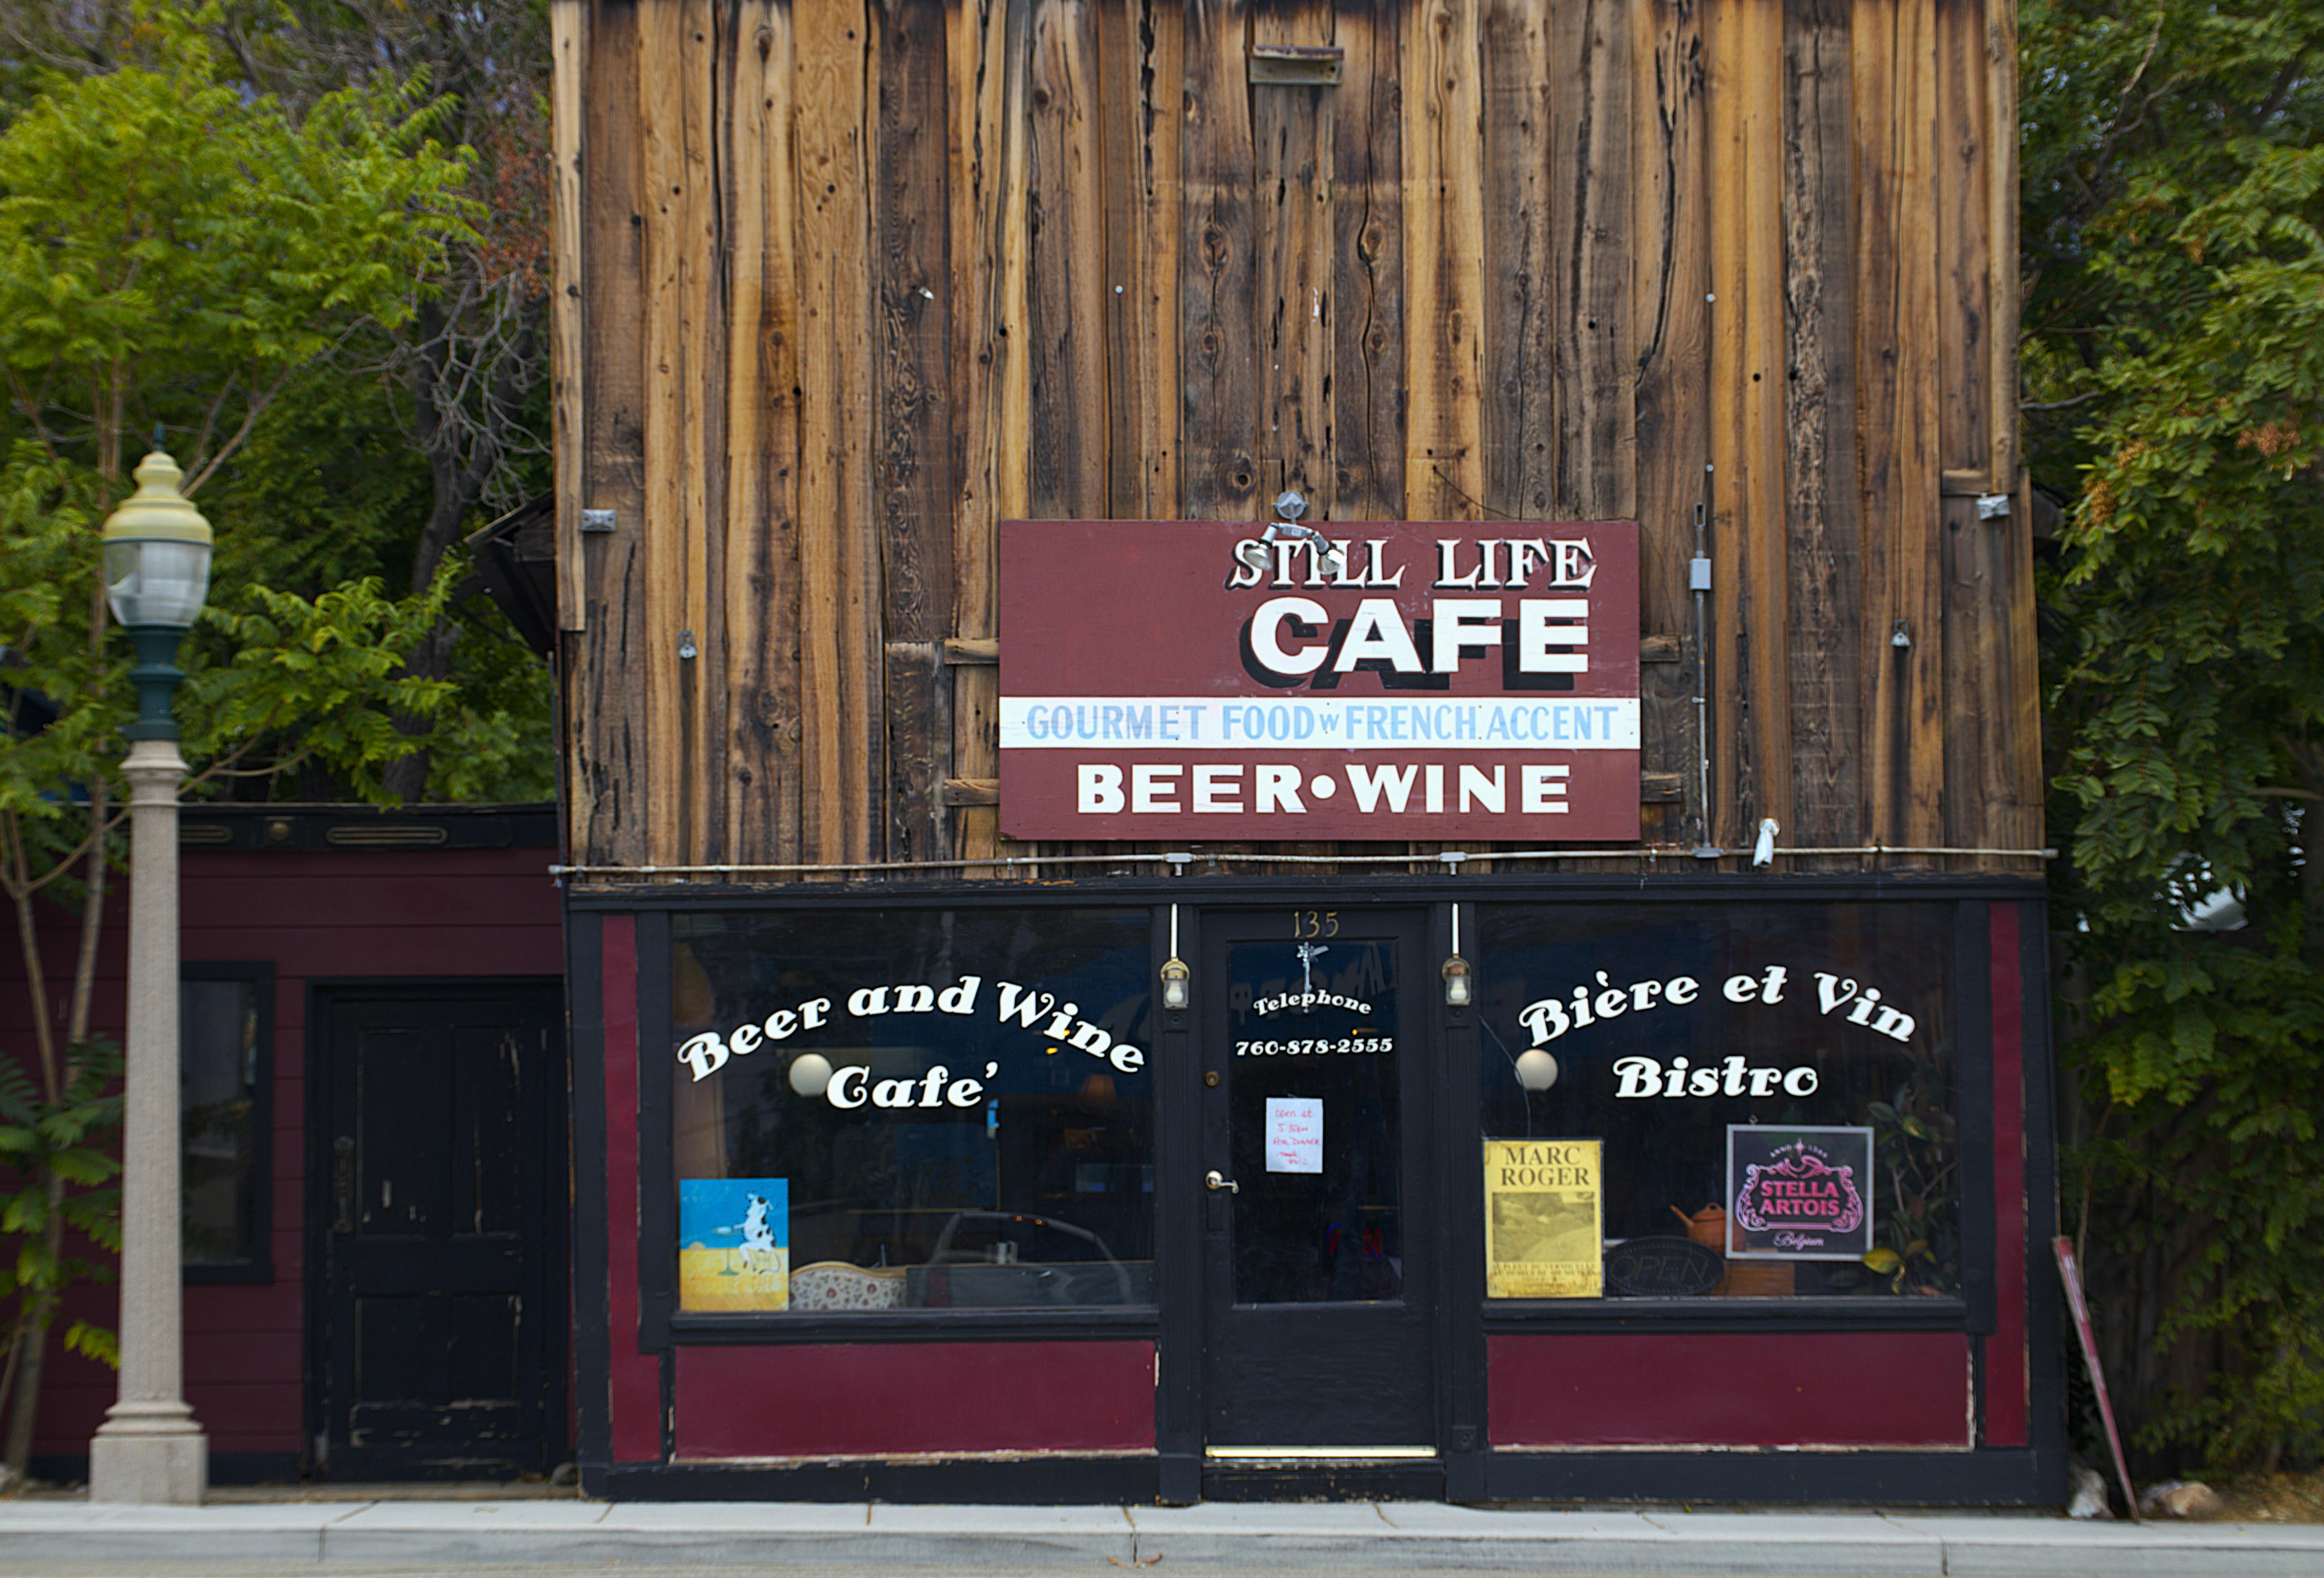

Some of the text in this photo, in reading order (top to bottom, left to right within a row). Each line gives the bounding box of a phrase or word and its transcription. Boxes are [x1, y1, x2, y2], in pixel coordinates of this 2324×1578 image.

[1226, 537, 1597, 590] STILL LIFE
[1249, 597, 1589, 675] CAFE
[1026, 705, 1207, 740] GOURMET
[1222, 705, 1316, 741] FOOD
[1345, 704, 1478, 741] FRENCH
[1485, 705, 1620, 741] ACCENT
[1345, 764, 1570, 814] WINE
[1294, 911, 1339, 938] 135
[1253, 989, 1372, 1016] Telephone
[1519, 965, 1916, 1047] Bière et Vin
[677, 975, 1145, 1082] Beer and Wine
[1236, 1038, 1393, 1056] 760-878-2555
[1613, 1056, 1818, 1098] Bistro
[1505, 1147, 1581, 1165] MARC
[1501, 1167, 1590, 1187] ROGER
[1760, 1180, 1840, 1198] STELLA
[1759, 1198, 1841, 1216] ARTOIS
[1609, 1254, 1710, 1285] OPEN
